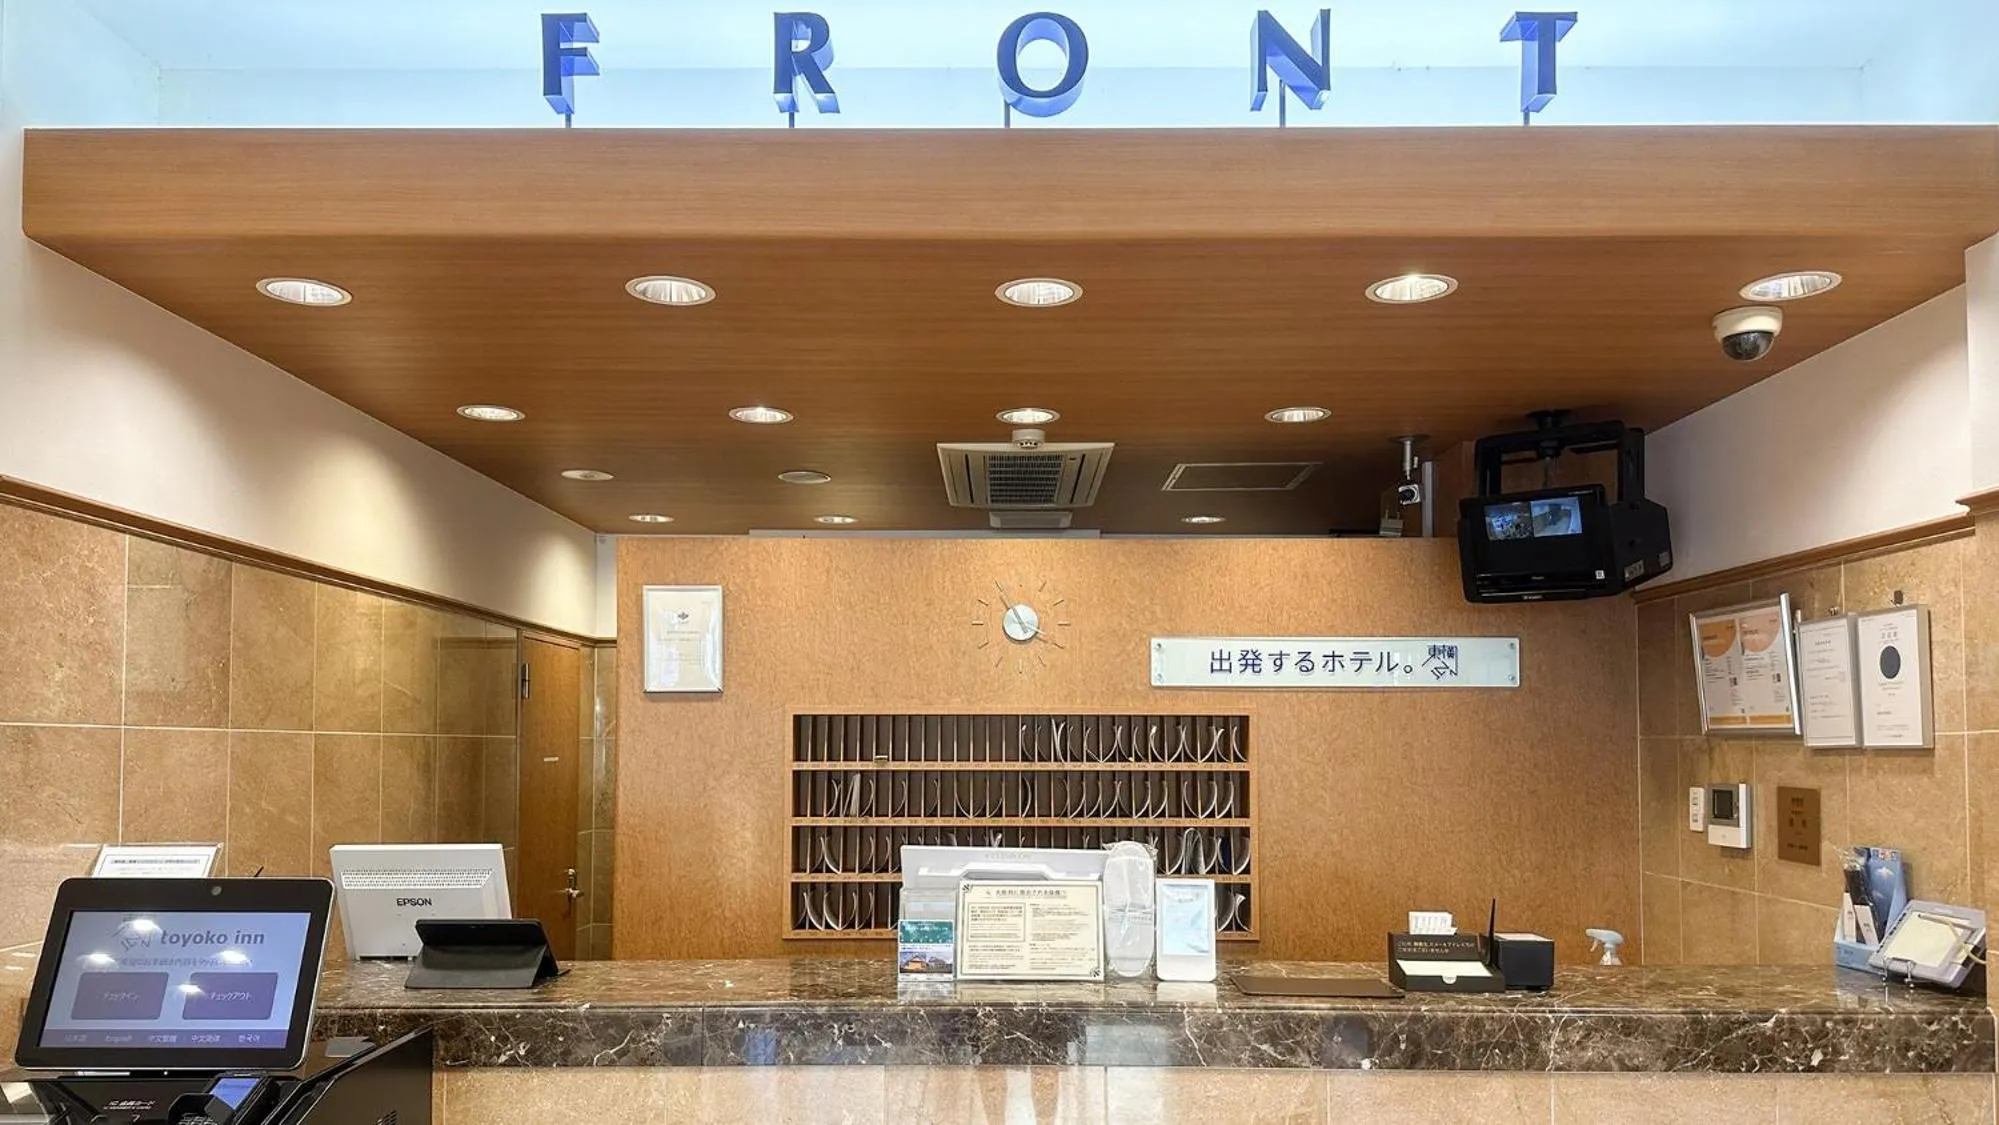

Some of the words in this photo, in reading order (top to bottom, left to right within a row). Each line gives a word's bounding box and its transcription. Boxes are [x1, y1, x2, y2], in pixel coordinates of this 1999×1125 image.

[540, 9, 1579, 116] FRONT
[1209, 649, 1414, 675] 出発するホテル。
[396, 897, 433, 907] EPSON
[160, 930, 228, 948] toyoko
[234, 930, 265, 945] inn
